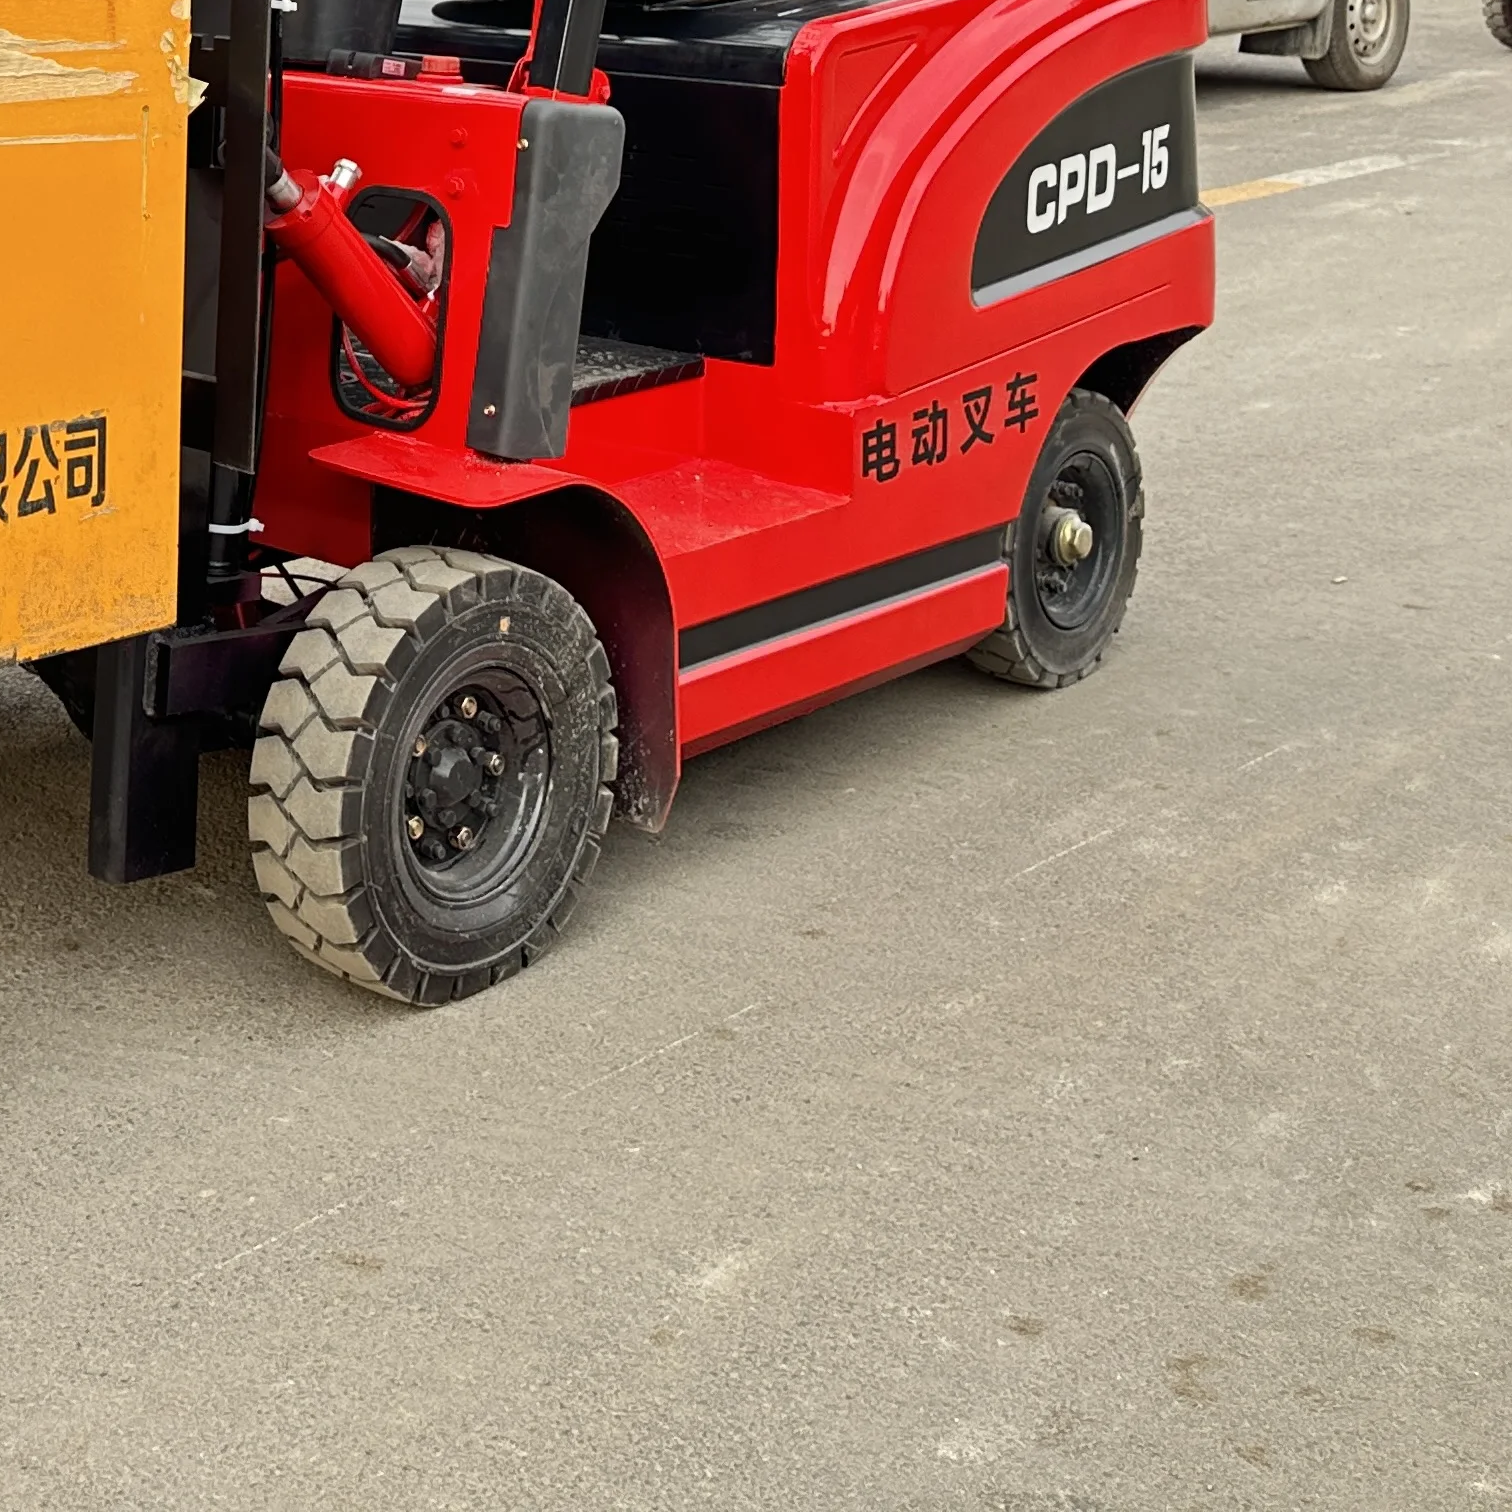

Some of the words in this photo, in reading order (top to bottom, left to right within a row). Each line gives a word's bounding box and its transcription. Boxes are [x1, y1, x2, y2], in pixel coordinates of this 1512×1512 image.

[1026, 123, 1171, 235] CPD-15
[861, 371, 1039, 483] 电动叉车
